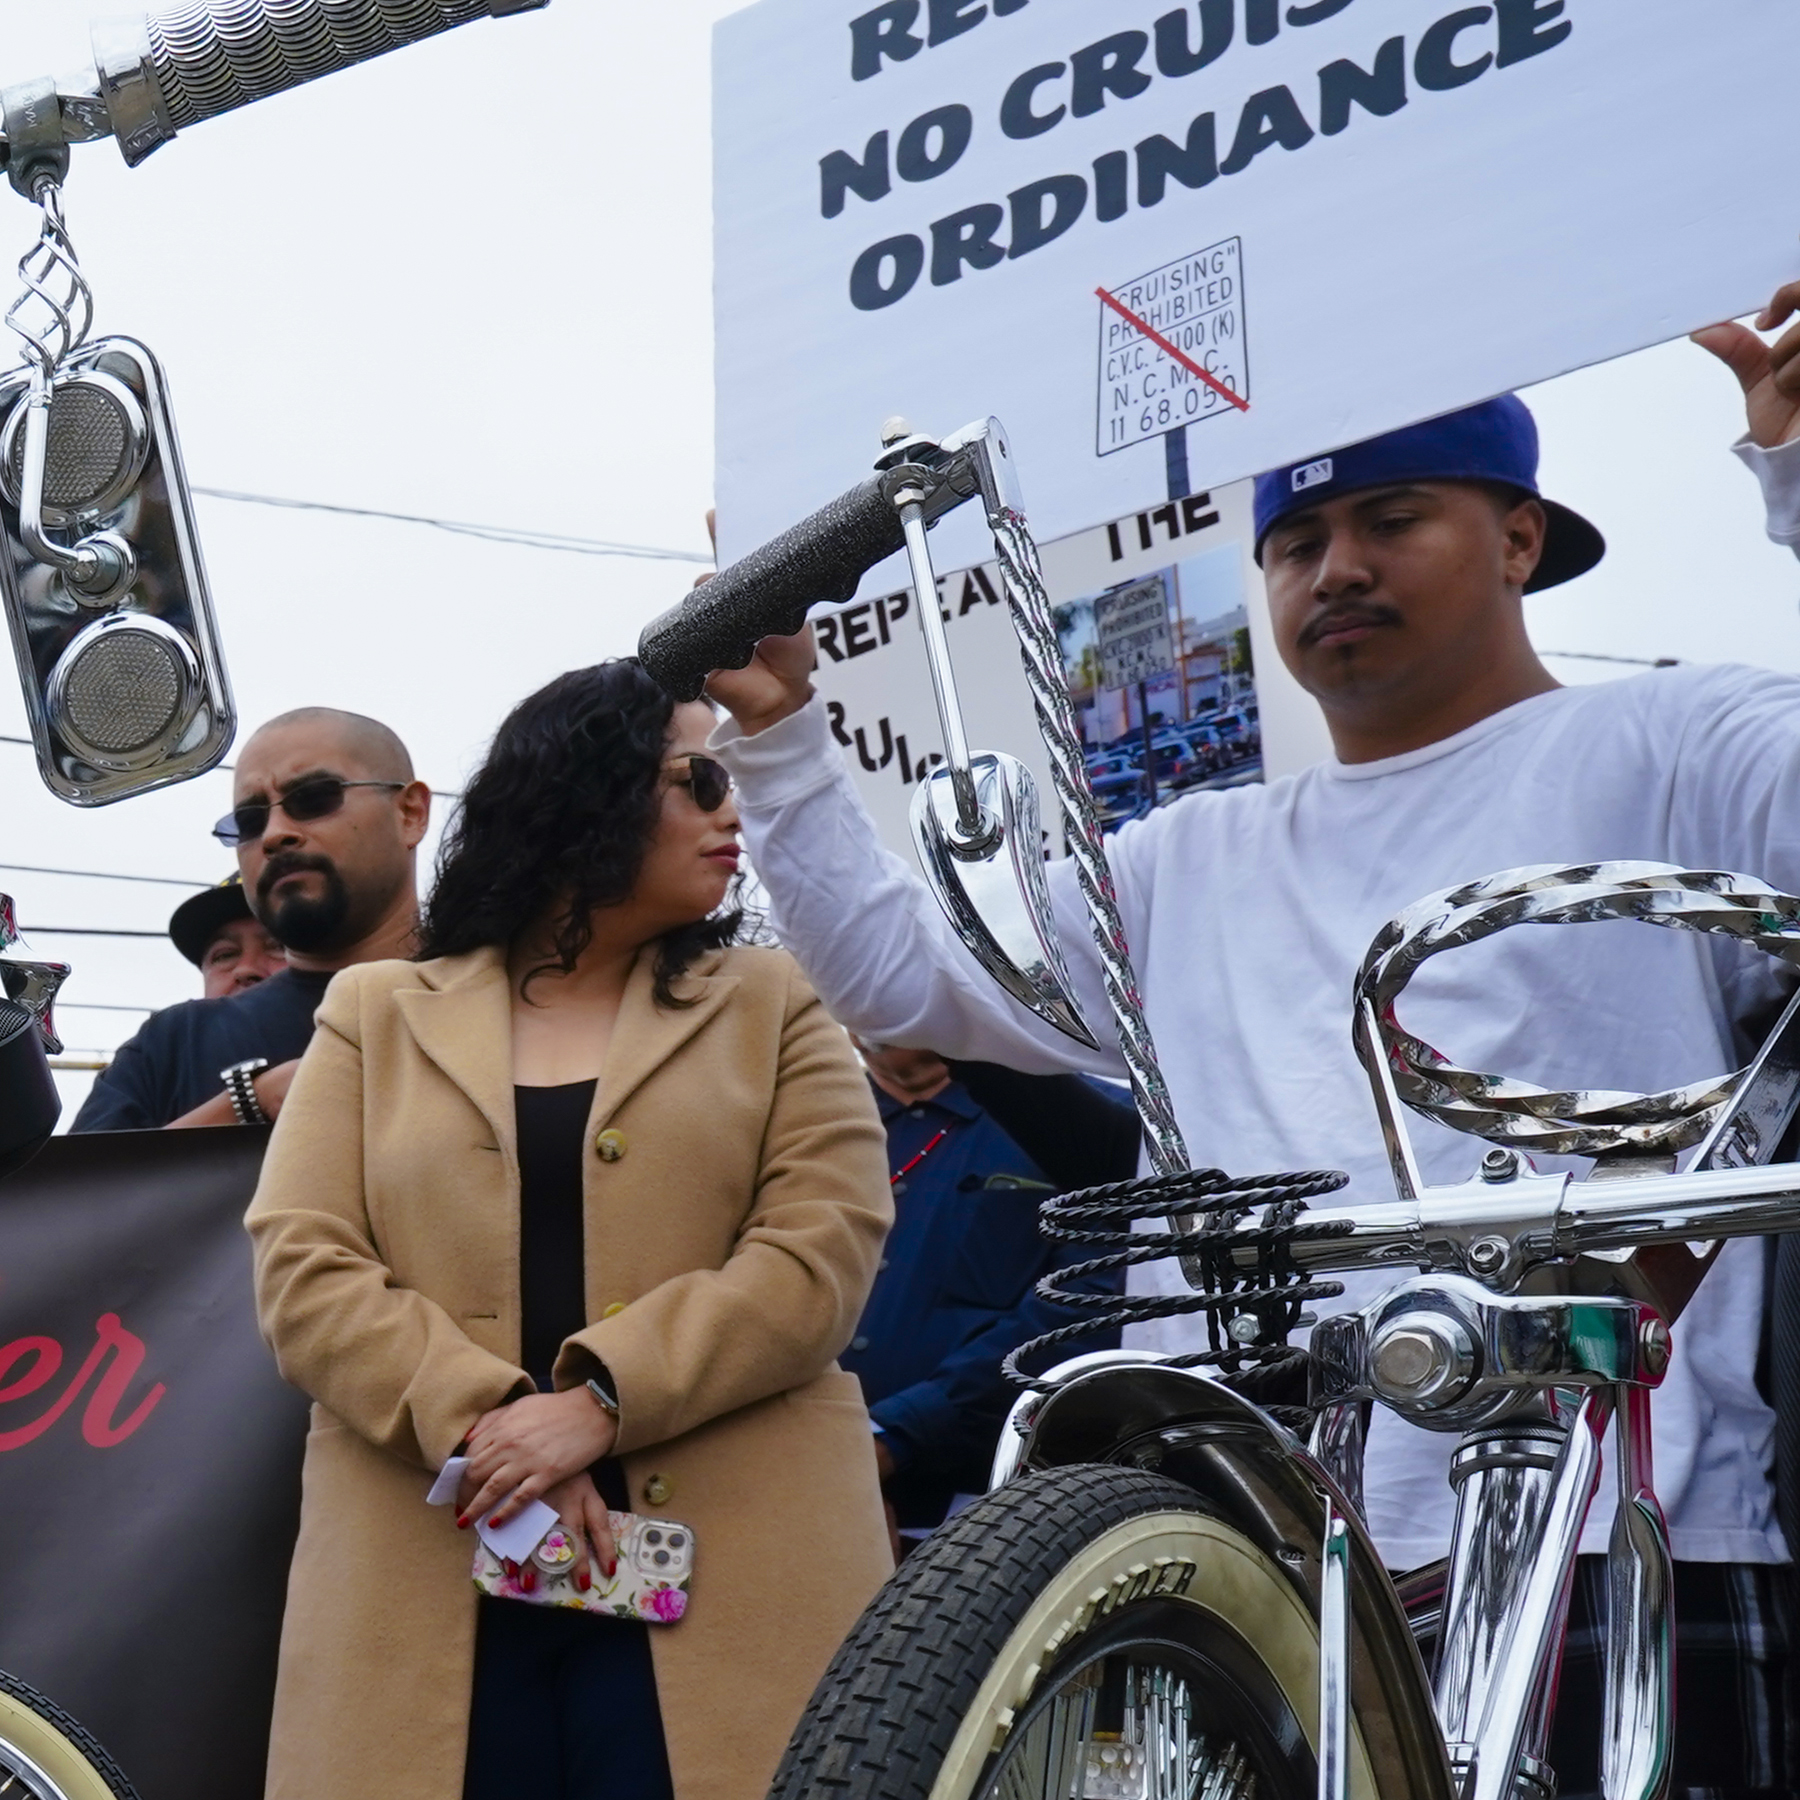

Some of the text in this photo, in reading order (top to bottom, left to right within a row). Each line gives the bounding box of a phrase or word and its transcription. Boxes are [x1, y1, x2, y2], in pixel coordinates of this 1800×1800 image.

[819, 102, 973, 220] NO
[848, 0, 1574, 312] ORDINANCE
[1108, 276, 1233, 348] PROHIBITED
